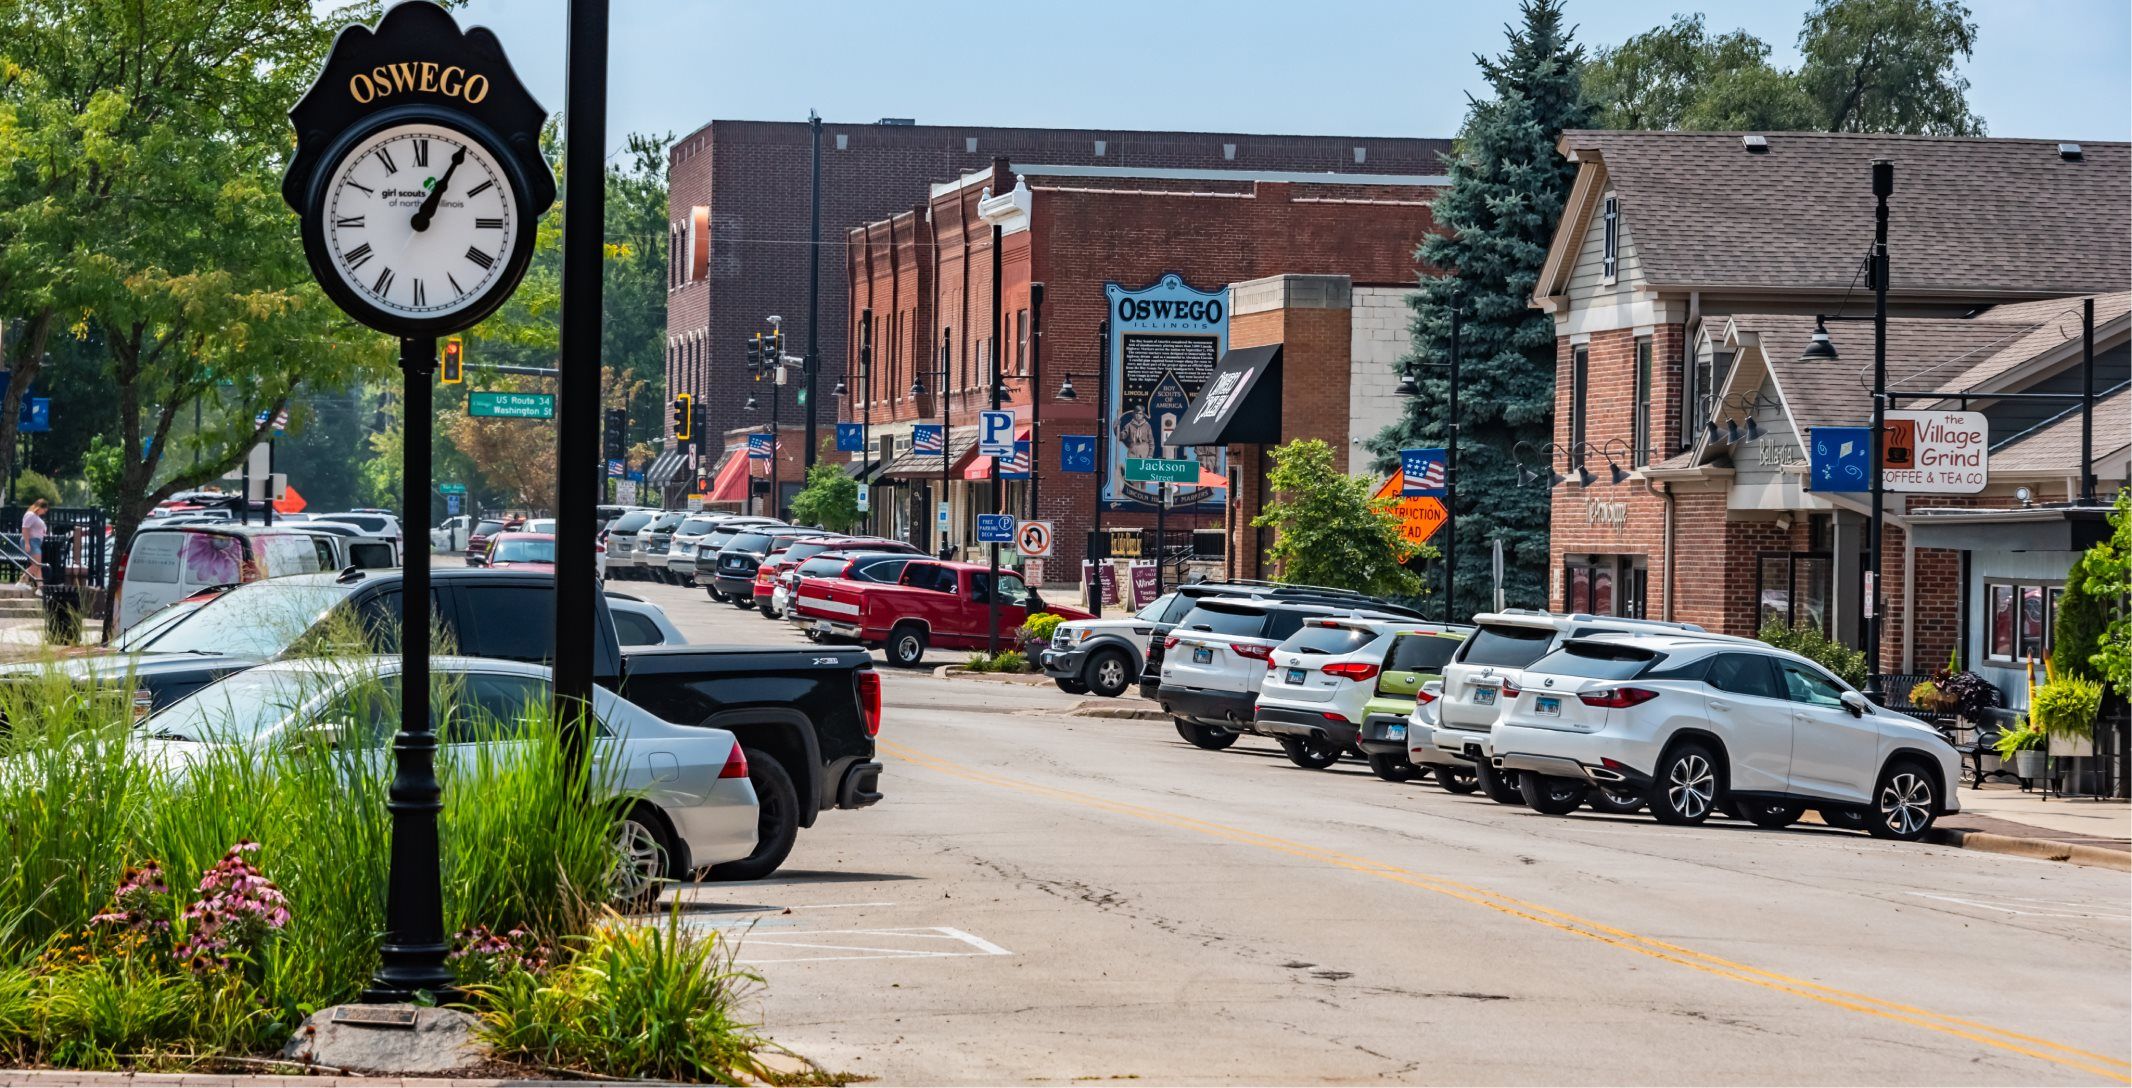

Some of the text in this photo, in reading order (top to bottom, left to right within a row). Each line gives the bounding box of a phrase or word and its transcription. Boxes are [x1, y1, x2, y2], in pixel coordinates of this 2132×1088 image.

[350, 62, 489, 104] OSWEGO
[382, 188, 426, 199] girl scouts
[389, 199, 397, 207] of
[1118, 297, 1223, 324] OSWEGO
[496, 396, 508, 404] US
[511, 396, 535, 405] Route
[539, 397, 550, 406] 34
[493, 406, 552, 416] Washington St
[1944, 415, 1964, 424] the
[982, 413, 1012, 444] P
[1916, 418, 1982, 449] Village
[1921, 448, 1980, 467] Grind
[1139, 459, 1186, 472] Jackson
[1150, 473, 1174, 482] Street
[1926, 472, 1935, 484] &
[1940, 472, 1962, 484] TEA
[1395, 525, 1422, 538] EAD
